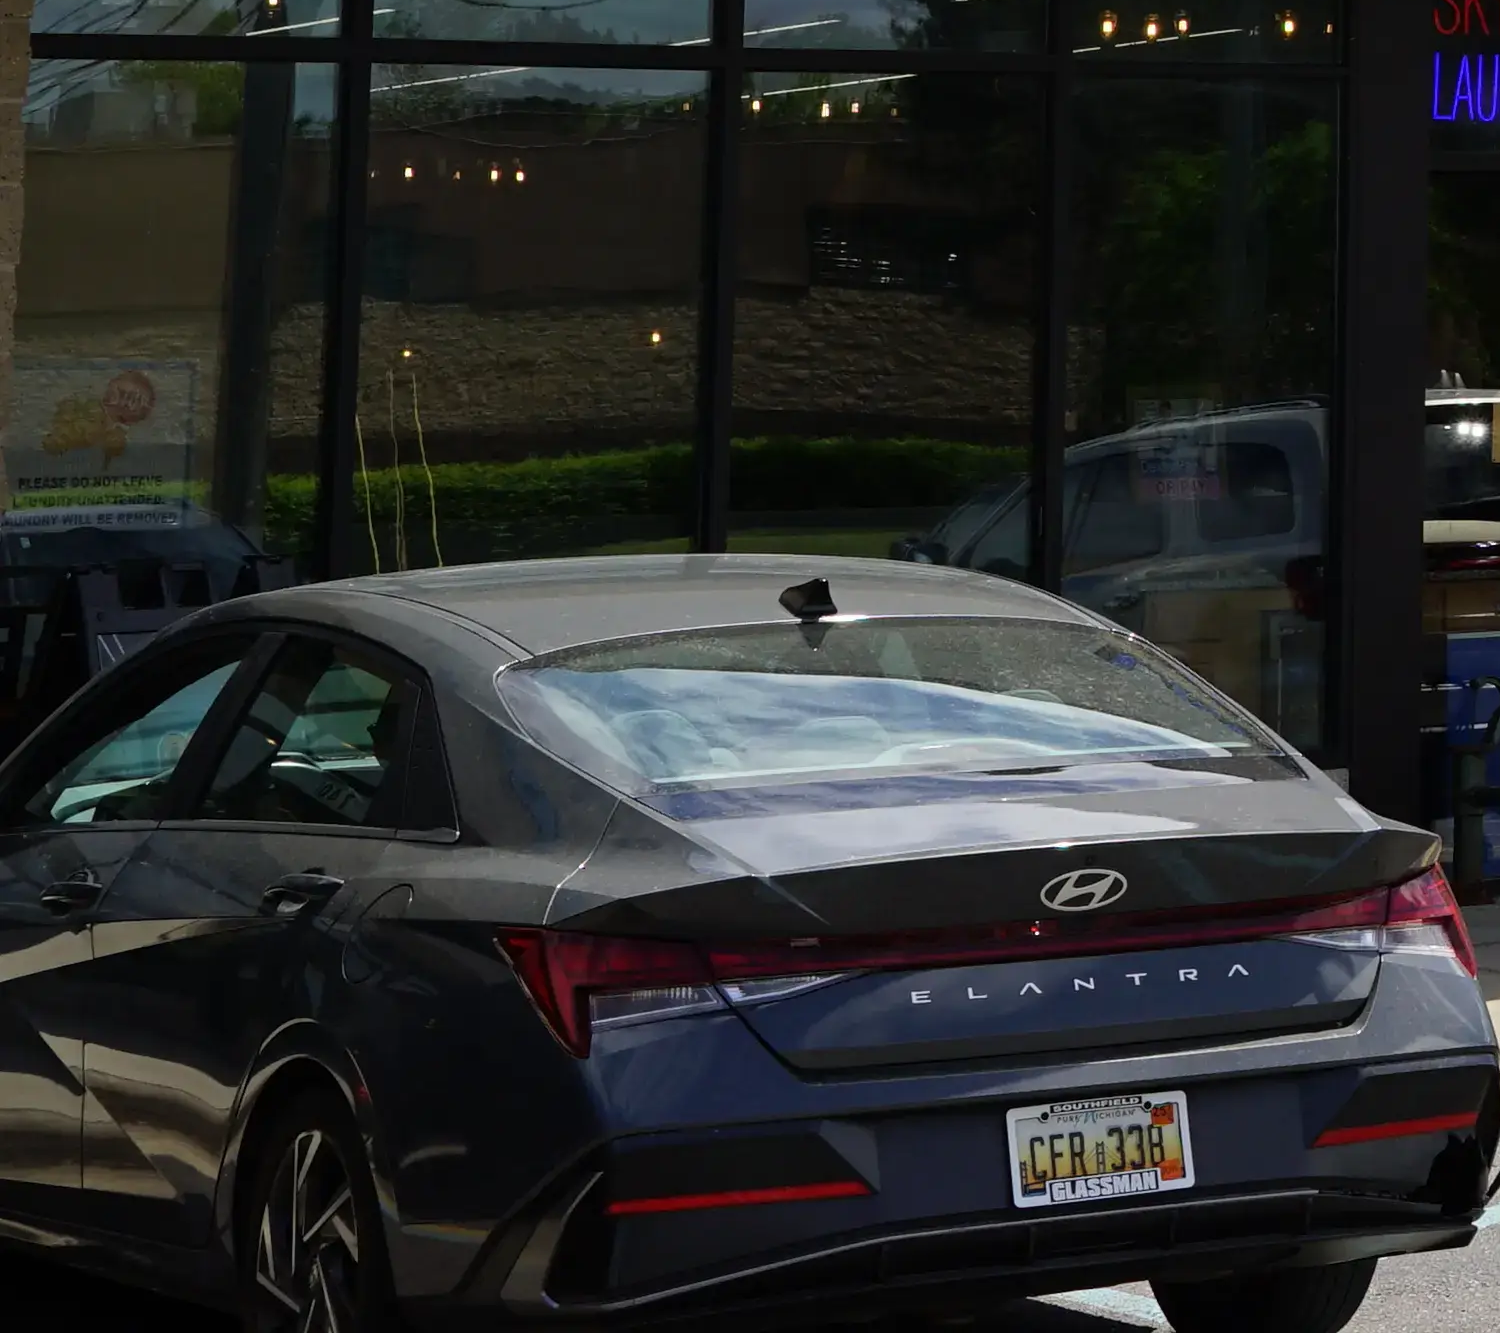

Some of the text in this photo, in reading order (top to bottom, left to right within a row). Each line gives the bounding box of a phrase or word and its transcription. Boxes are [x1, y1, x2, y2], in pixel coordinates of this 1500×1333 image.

[18, 476, 68, 489] PLEASE
[72, 476, 91, 488] DO
[93, 475, 118, 487] NOT
[62, 513, 93, 525] WILL
[97, 513, 113, 524] BE
[910, 963, 1250, 1005] ELANTRA
[1052, 1096, 1140, 1113] SOUTHFIELD
[1056, 1108, 1136, 1124] PURE MICHIGAN
[1051, 1171, 1158, 1202] GLASSMAN
